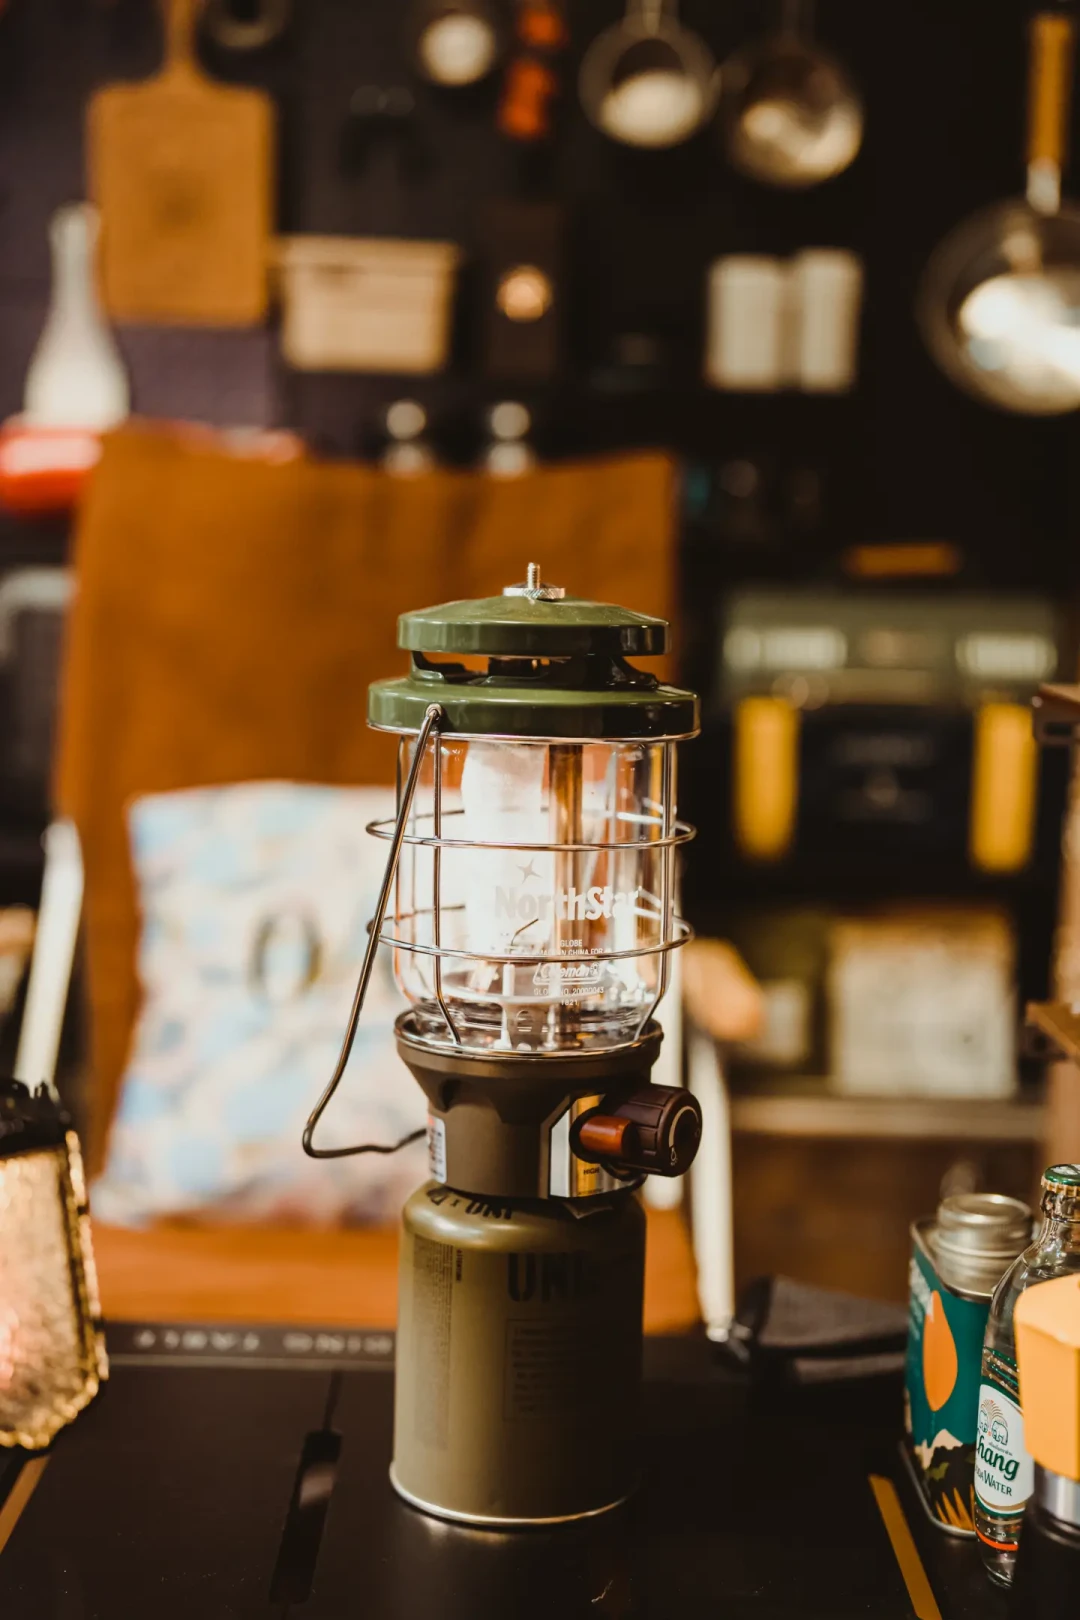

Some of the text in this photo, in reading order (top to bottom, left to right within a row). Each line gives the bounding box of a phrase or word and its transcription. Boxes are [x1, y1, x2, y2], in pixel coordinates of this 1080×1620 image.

[494, 885, 638, 921] NorthStar
[560, 939, 582, 947] GLOBE
[590, 947, 604, 955] FOR
[533, 987, 554, 996] GLO
[583, 1167, 600, 1175] HIGH
[976, 1434, 1021, 1481] hang
[983, 1469, 1013, 1497] WATER
